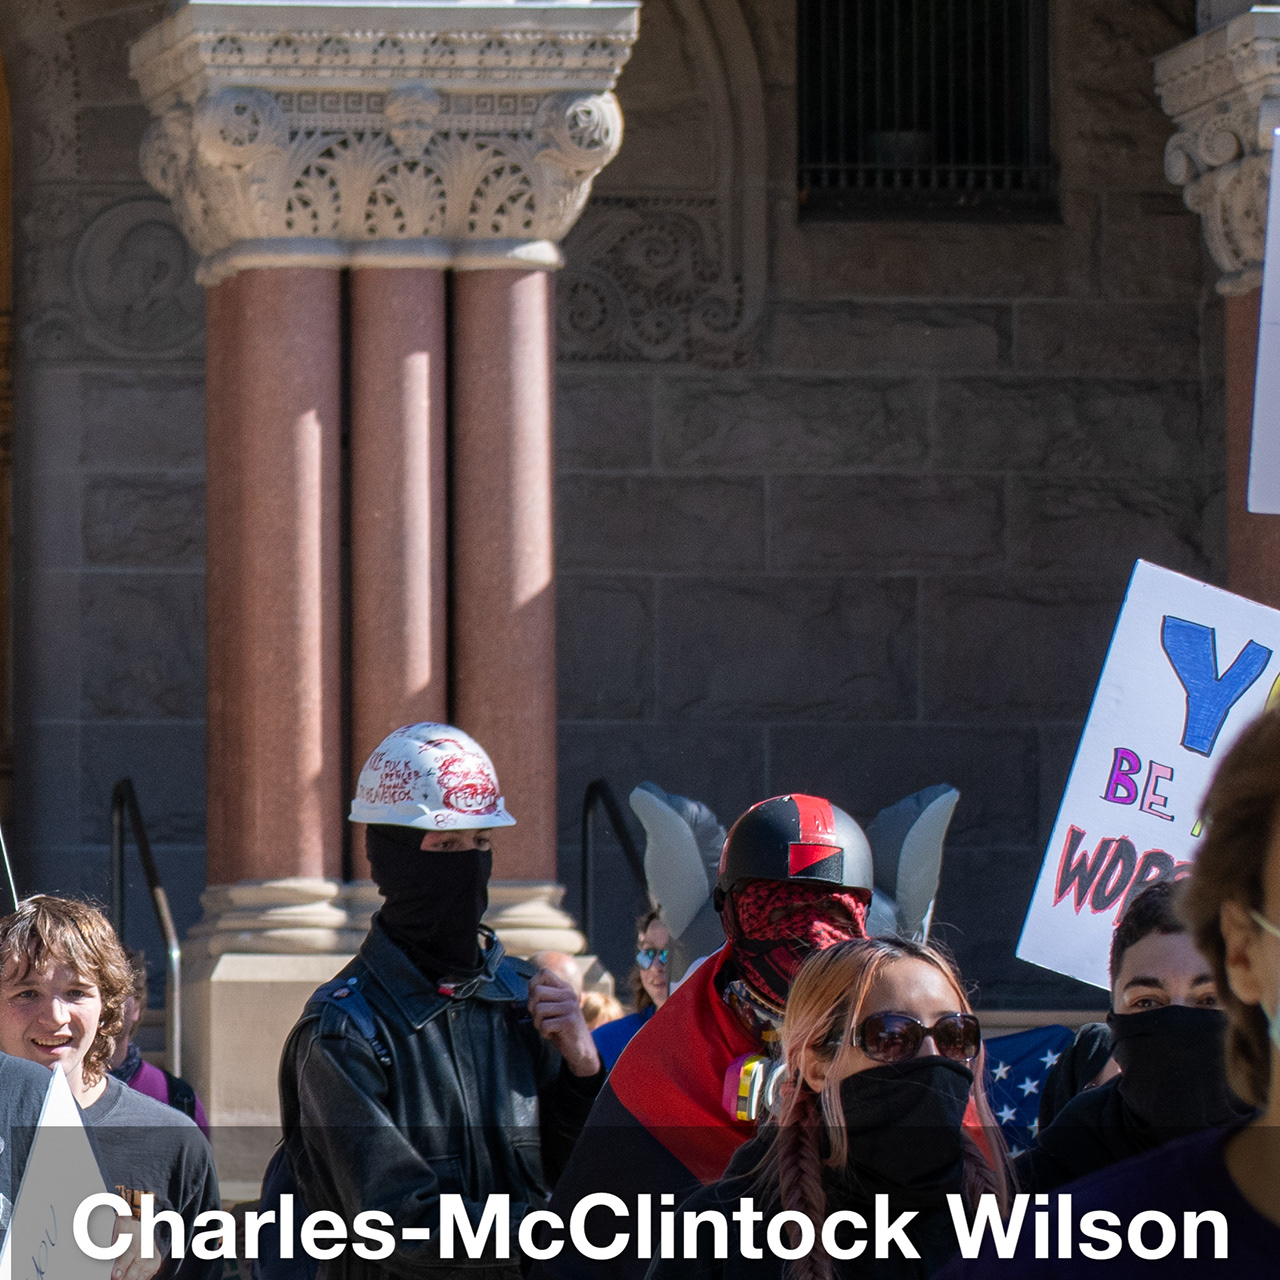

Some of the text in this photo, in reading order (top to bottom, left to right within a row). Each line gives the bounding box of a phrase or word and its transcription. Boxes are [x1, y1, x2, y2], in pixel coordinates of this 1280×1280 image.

[1160, 615, 1280, 758] Y
[1099, 747, 1175, 822] BE
[1052, 824, 1194, 926] WOR
